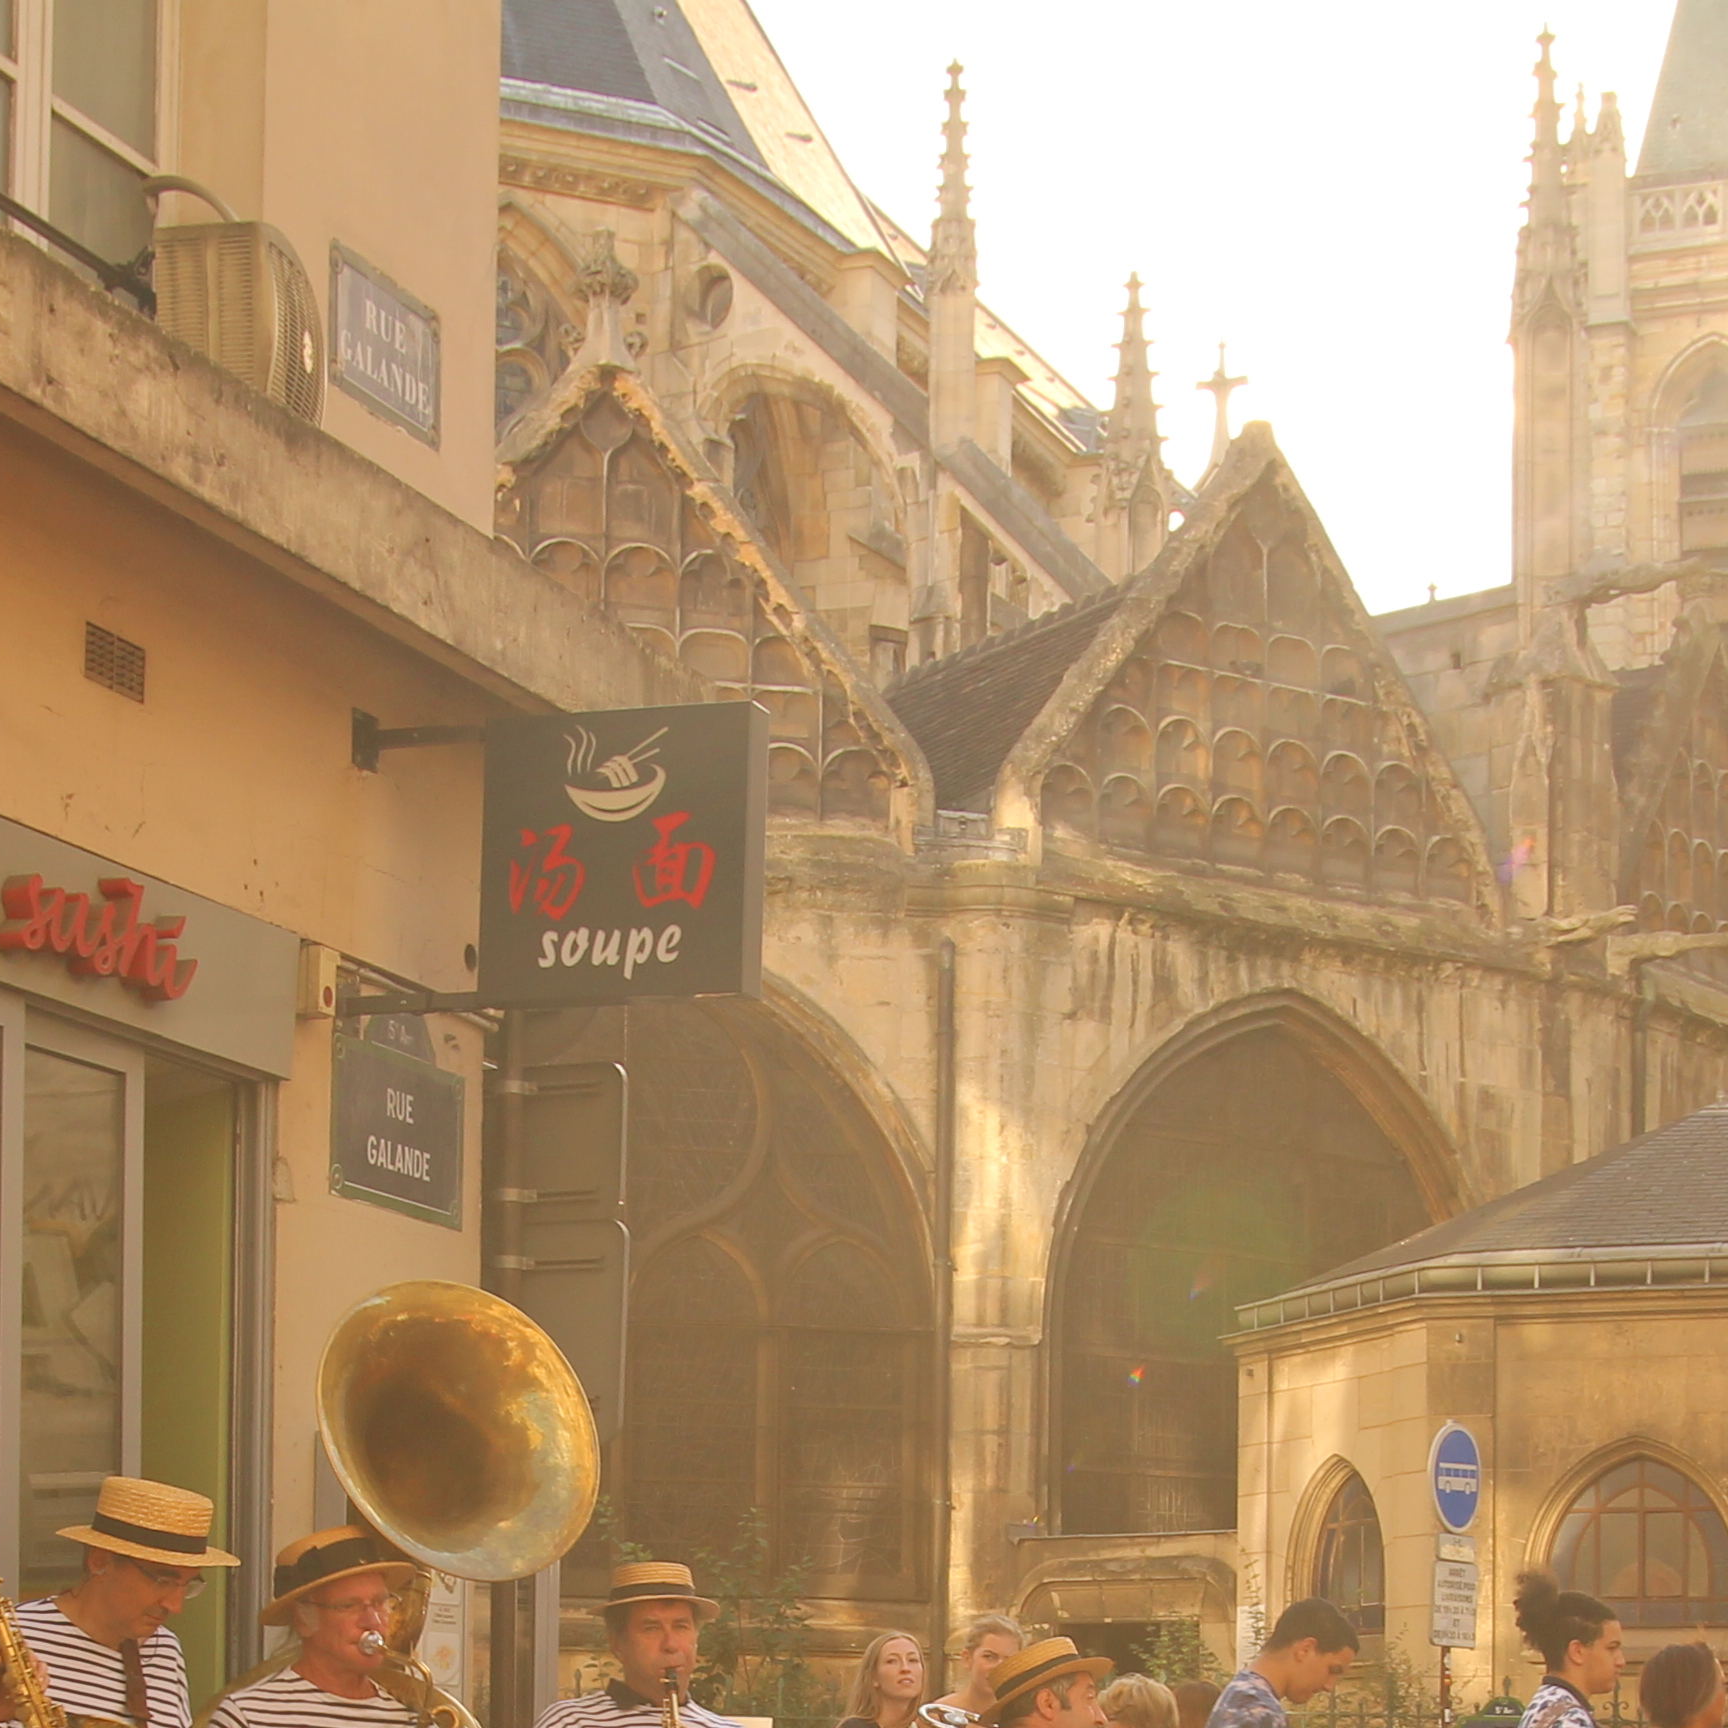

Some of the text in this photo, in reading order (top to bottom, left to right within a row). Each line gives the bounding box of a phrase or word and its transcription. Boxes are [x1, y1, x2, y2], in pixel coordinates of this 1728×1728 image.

[365, 299, 406, 355] RUE
[341, 329, 430, 416] GALANDE
[509, 811, 717, 921] 汤面
[537, 924, 682, 980] soupe
[387, 1088, 414, 1125] RUE
[367, 1135, 431, 1182] GALANDE
